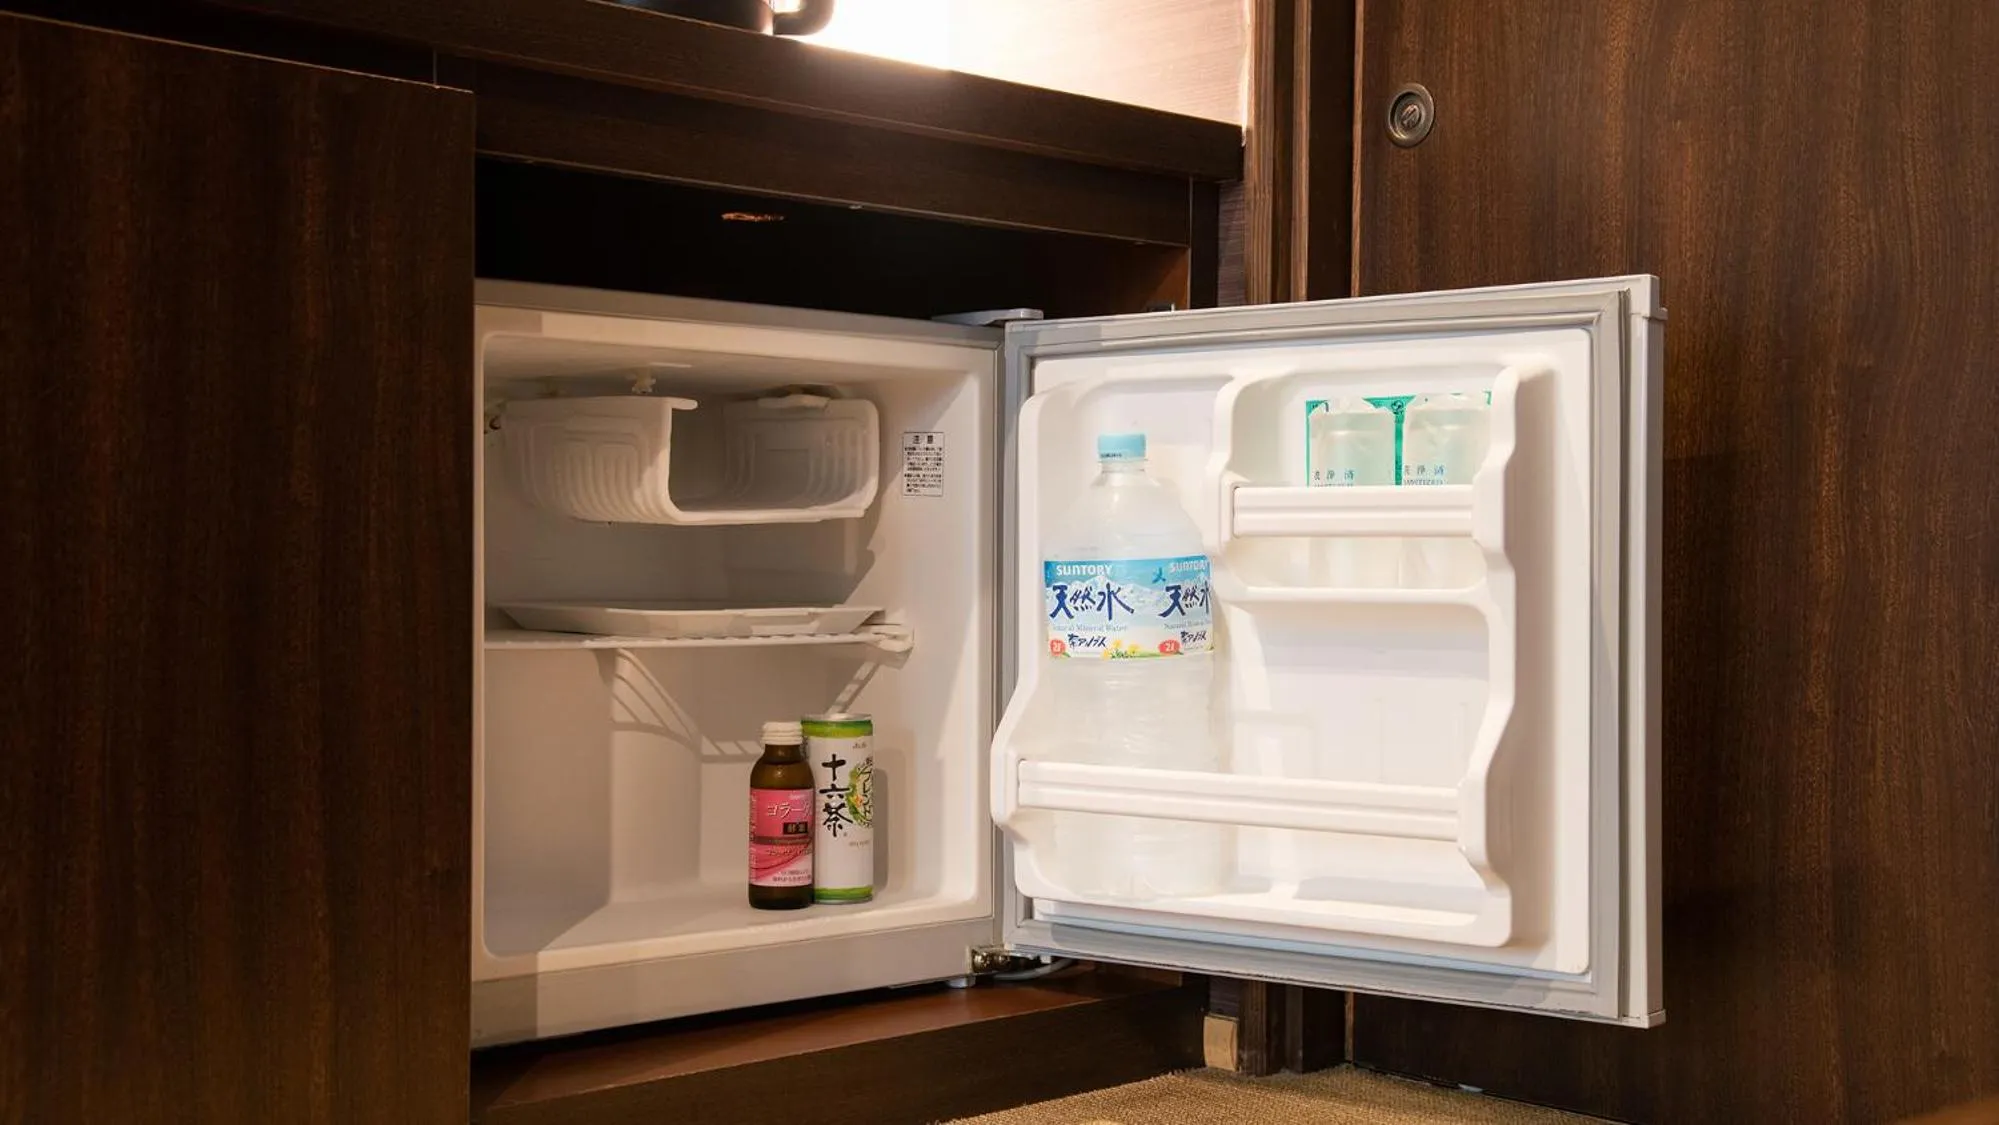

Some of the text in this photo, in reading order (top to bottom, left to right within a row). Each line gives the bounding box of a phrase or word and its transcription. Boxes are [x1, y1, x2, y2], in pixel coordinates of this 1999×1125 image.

[1056, 564, 1113, 576] SUNTORY
[1169, 559, 1209, 573] SUNTOR
[1049, 581, 1135, 621] 天然水
[819, 753, 854, 838] 十六茶
